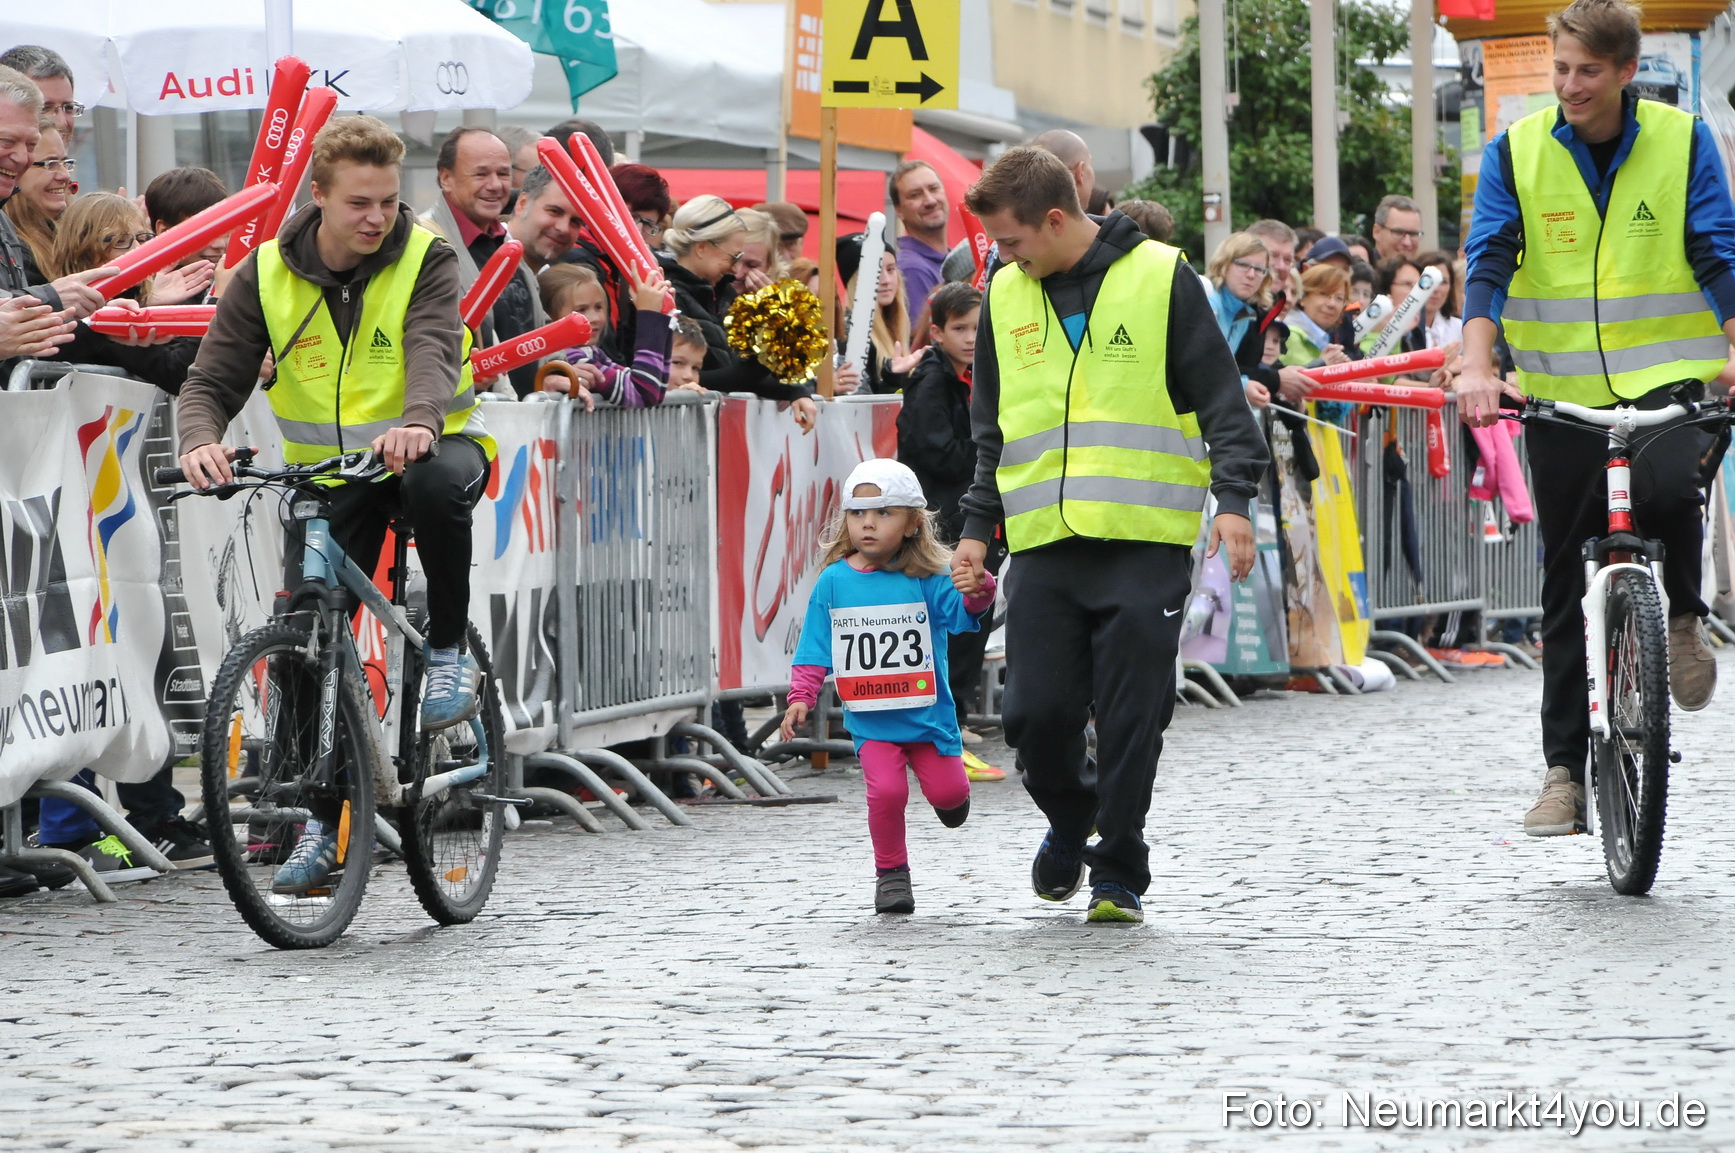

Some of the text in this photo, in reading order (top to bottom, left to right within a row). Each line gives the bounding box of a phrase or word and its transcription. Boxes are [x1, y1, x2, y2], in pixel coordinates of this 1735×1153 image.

[850, 0, 929, 60] A
[159, 68, 254, 100] Audi
[1323, 360, 1375, 377] Audi BKK
[833, 615, 912, 628] PARTL Neumarkt
[840, 629, 923, 671] 7023
[853, 680, 910, 697] Johanna
[321, 671, 336, 750] AXEL
